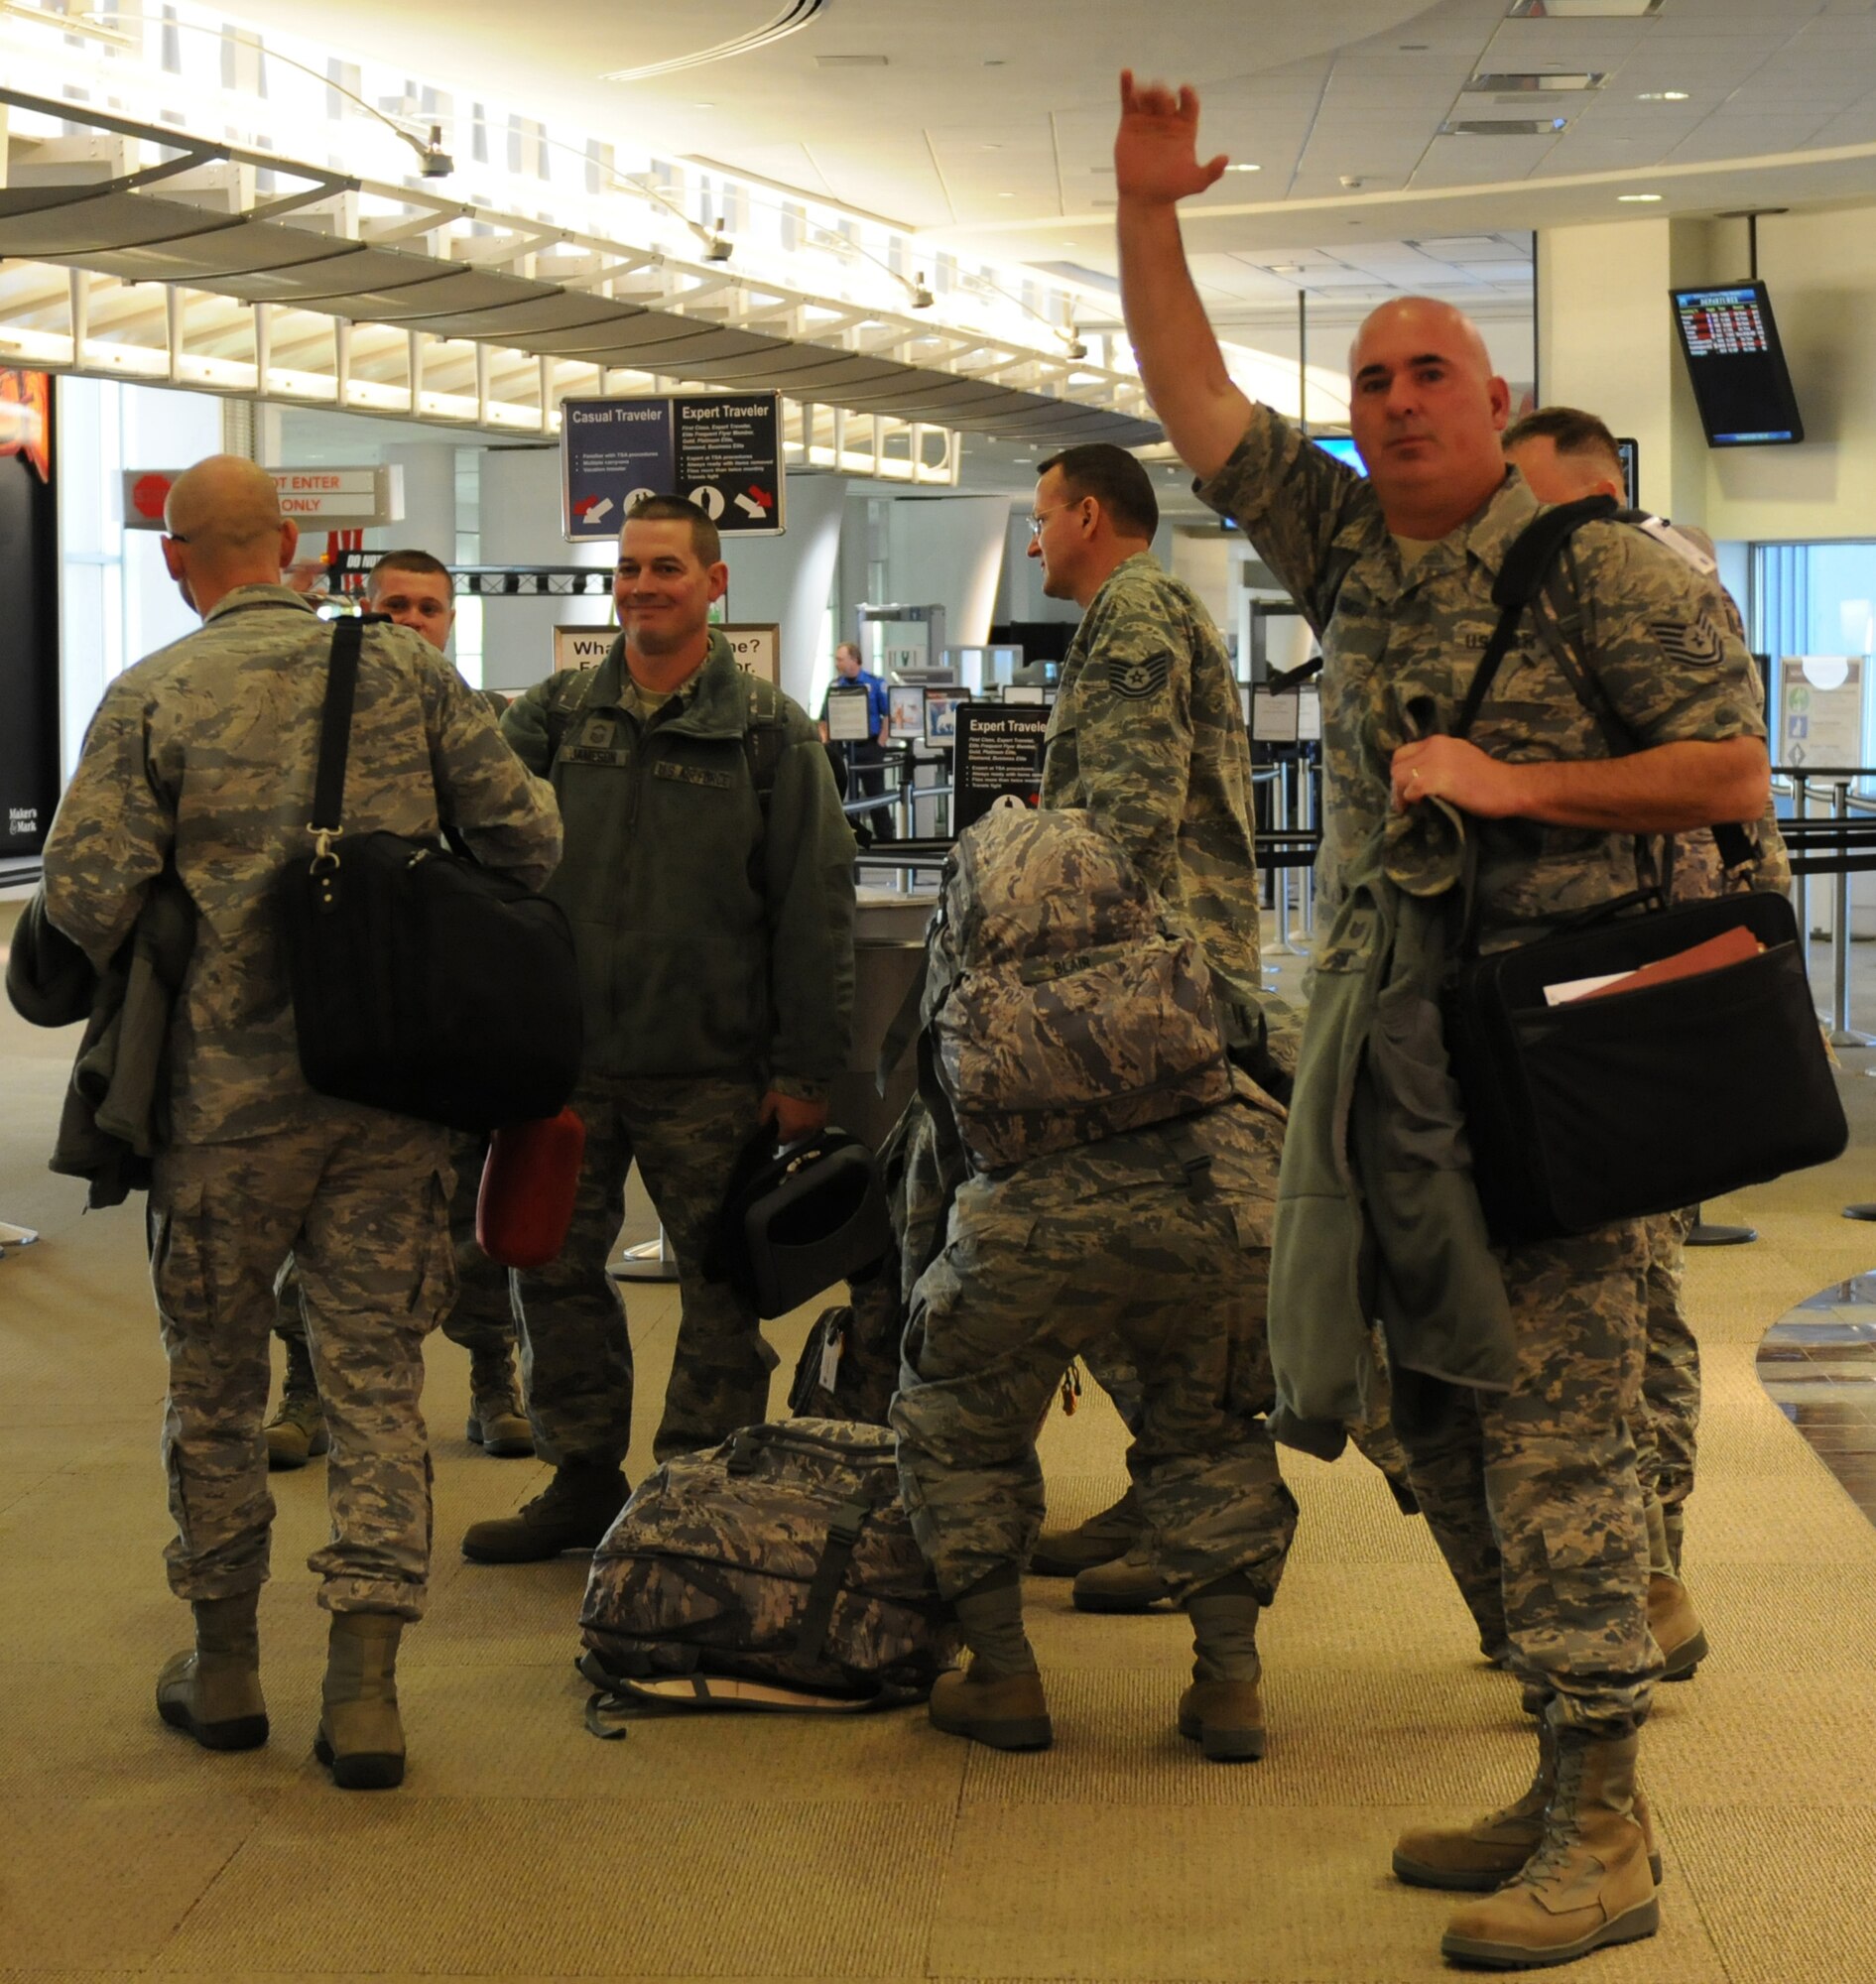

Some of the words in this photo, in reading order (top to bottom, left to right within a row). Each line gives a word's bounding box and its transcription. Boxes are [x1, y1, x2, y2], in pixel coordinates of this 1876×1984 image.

[572, 410, 612, 424] Casual
[615, 408, 662, 422] Traveler
[682, 406, 720, 422] Expert
[722, 404, 769, 418] Traveler
[292, 476, 340, 489] ENTER
[282, 499, 321, 512] ONLY
[346, 555, 362, 568] DO
[969, 719, 1005, 734] Expert
[1007, 719, 1048, 733] Travele
[9, 807, 38, 819] Maker's
[17, 820, 37, 832] Mark
[1054, 955, 1090, 975] BLAIR
